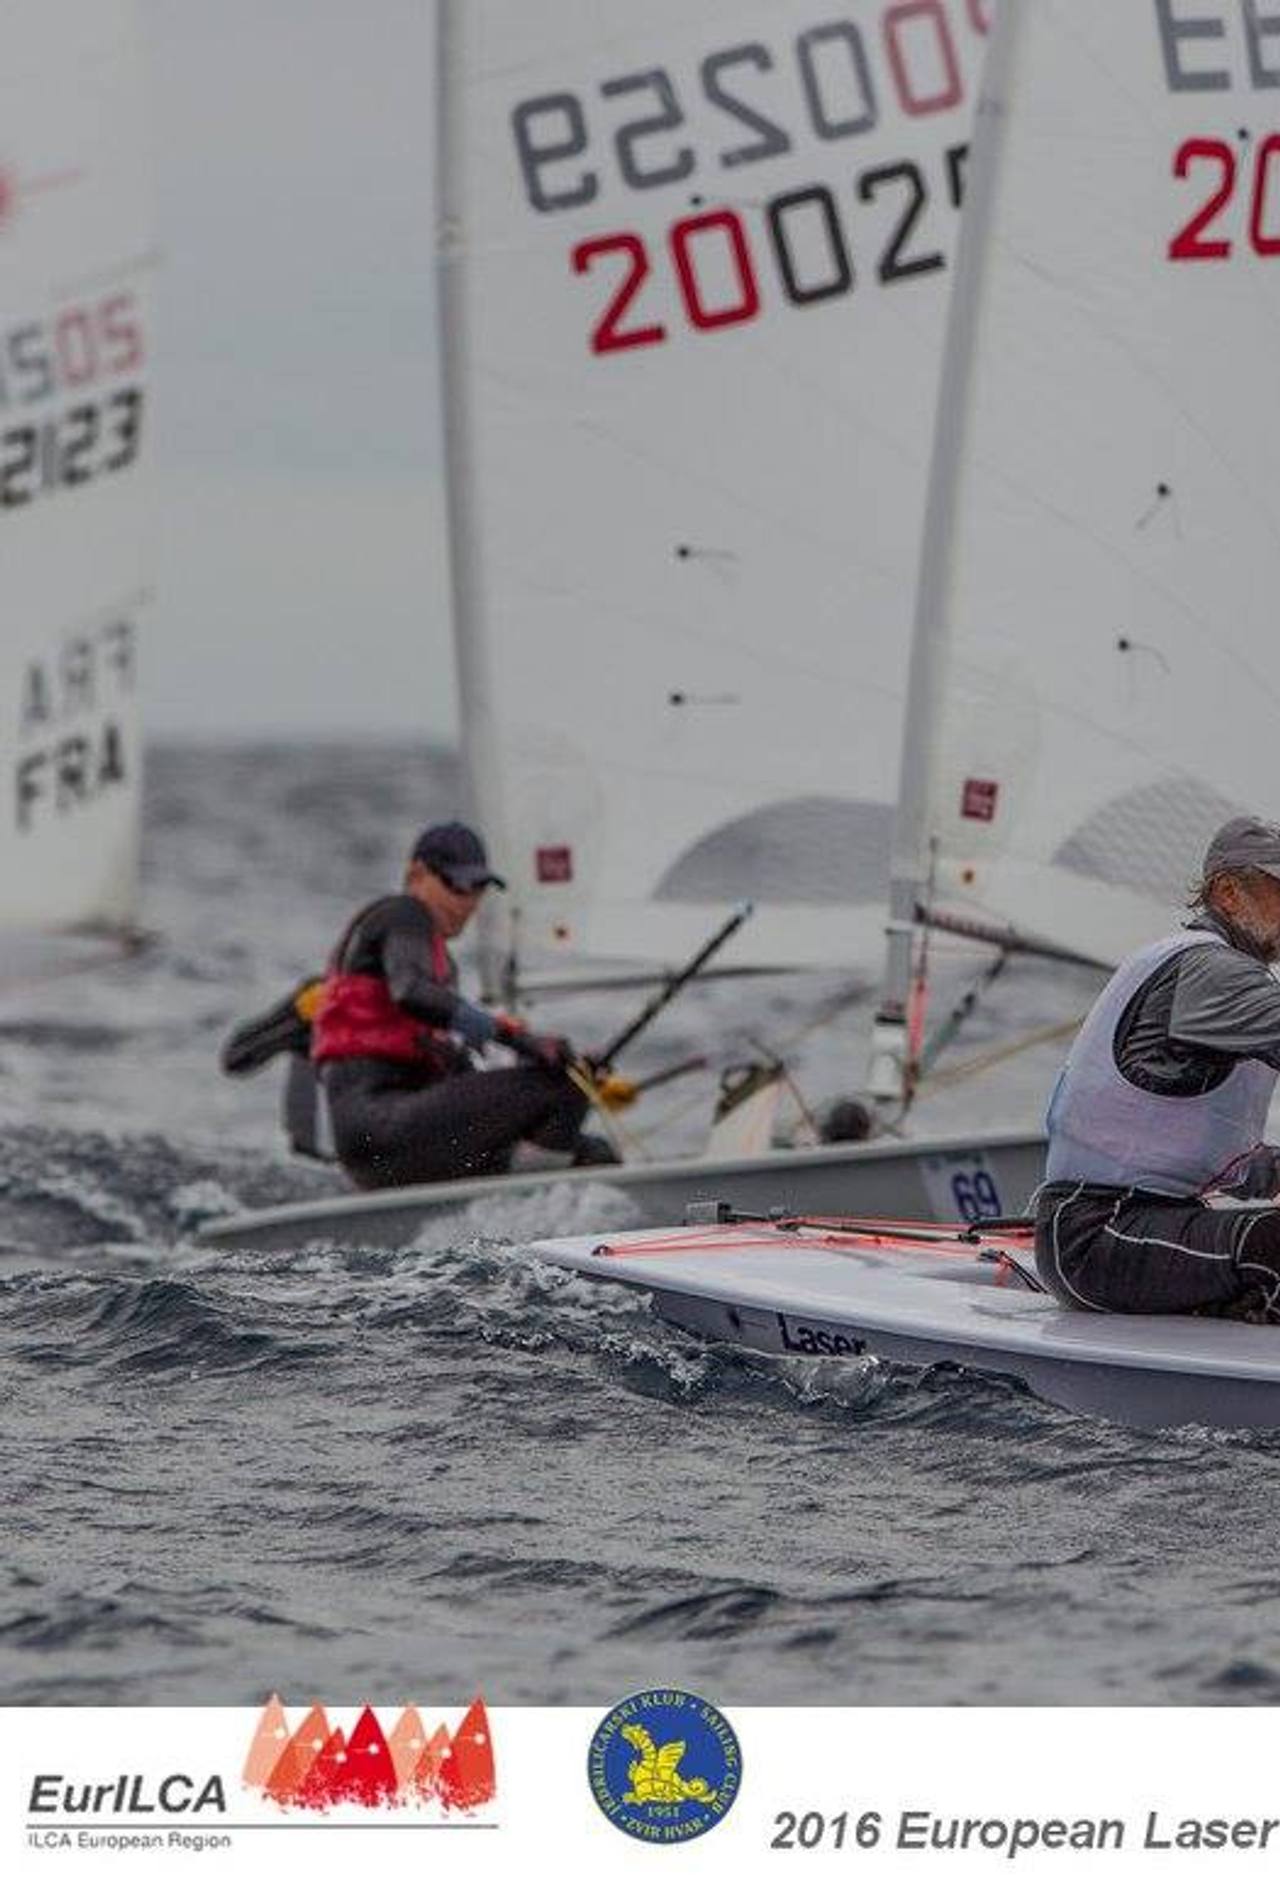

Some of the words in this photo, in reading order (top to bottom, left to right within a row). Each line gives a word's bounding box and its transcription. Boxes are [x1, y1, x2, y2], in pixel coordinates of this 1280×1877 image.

[15, 720, 125, 833] FRA
[952, 1171, 1001, 1223] 69
[776, 1311, 867, 1355] Laser
